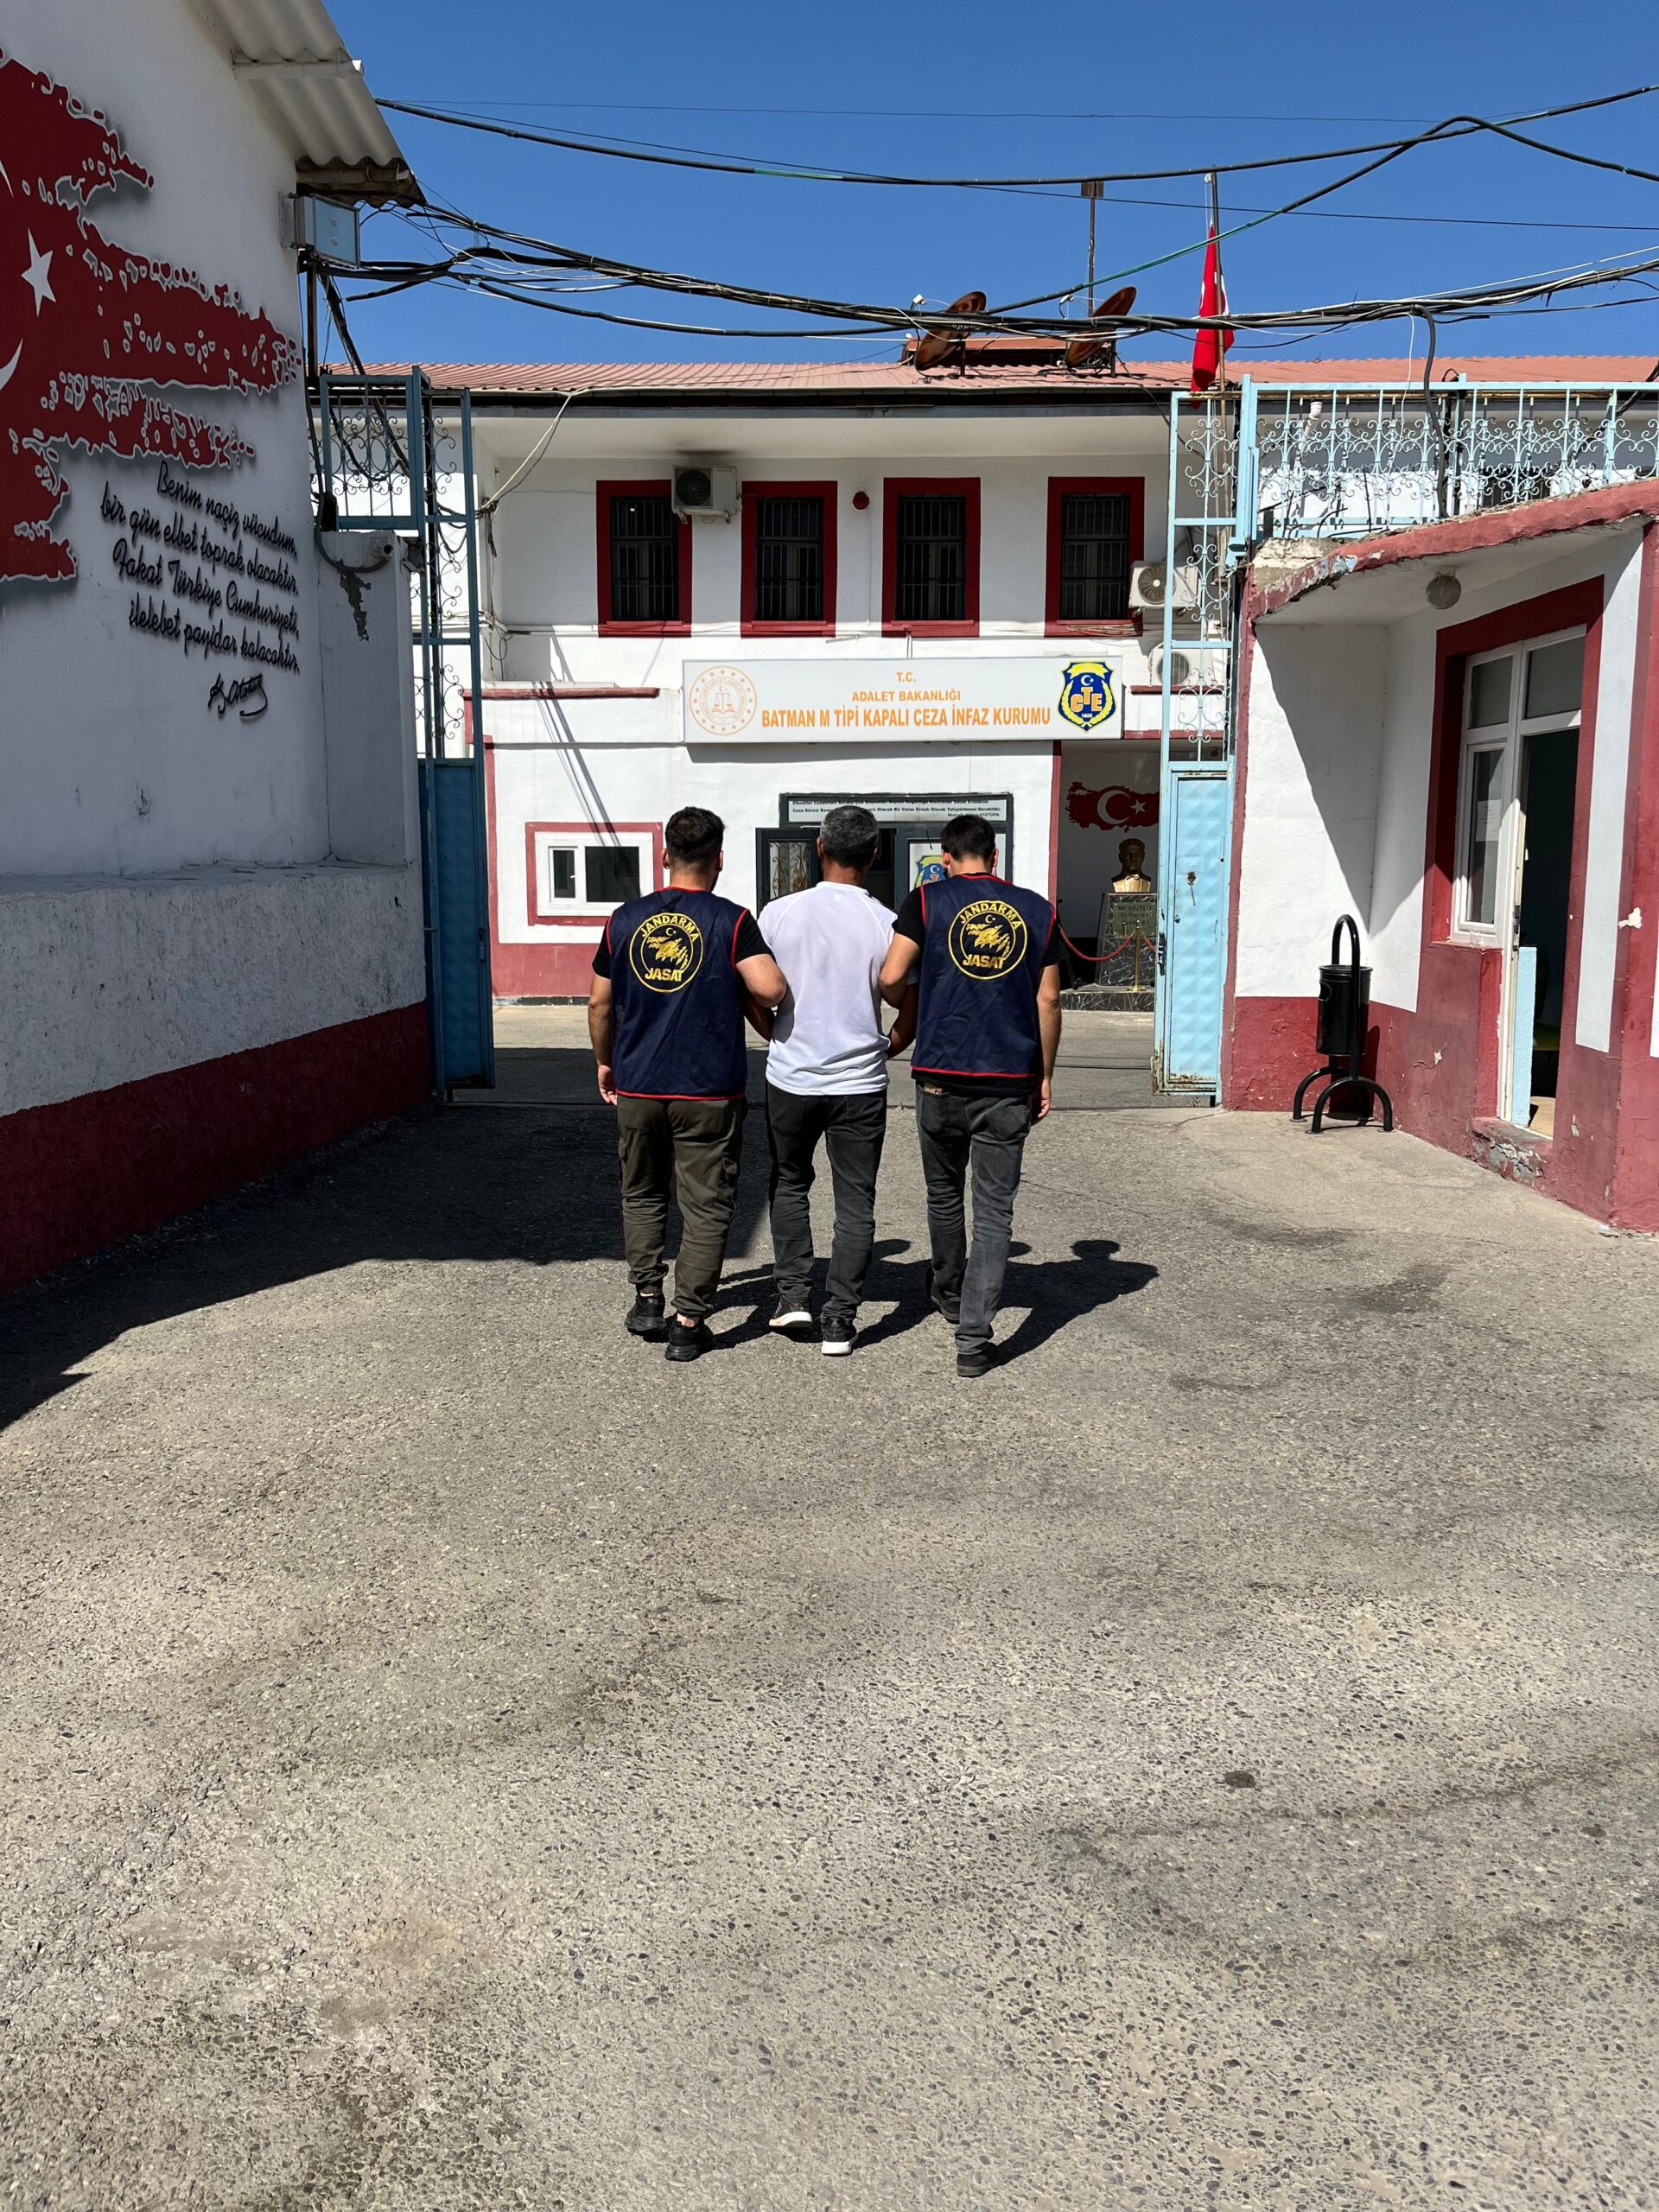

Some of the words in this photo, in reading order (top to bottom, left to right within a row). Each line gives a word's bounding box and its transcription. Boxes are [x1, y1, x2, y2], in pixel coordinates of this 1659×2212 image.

[157, 460, 202, 509] Benim
[100, 480, 126, 523] bir
[130, 508, 161, 544] gün
[163, 511, 198, 551] elbet
[200, 526, 245, 574] toprak
[246, 546, 299, 595] olacaktır.
[112, 537, 162, 585] Fakat
[168, 559, 223, 617] Türkiye
[226, 580, 299, 640] Cumhuriyeti,
[129, 591, 181, 639] ilelebet
[183, 619, 238, 659] payidar
[241, 626, 300, 674] kalacaktır.
[896, 671, 917, 682] T.C.
[851, 690, 895, 702] ADALET
[899, 688, 961, 701] BAKANLIĞI
[1070, 686, 1103, 713] CTE
[761, 709, 815, 727] BATMAN
[819, 709, 830, 727] M
[834, 704, 859, 727] TİPİ
[863, 709, 909, 727] KAPALI
[913, 708, 948, 726] CEZA
[951, 704, 989, 726] İNFAZ
[993, 707, 1051, 725] KURUMU
[639, 915, 700, 942] JANDARMA
[960, 903, 1022, 931] JANDARMA
[645, 968, 684, 982] JASAT
[963, 954, 1007, 969] JASAT
